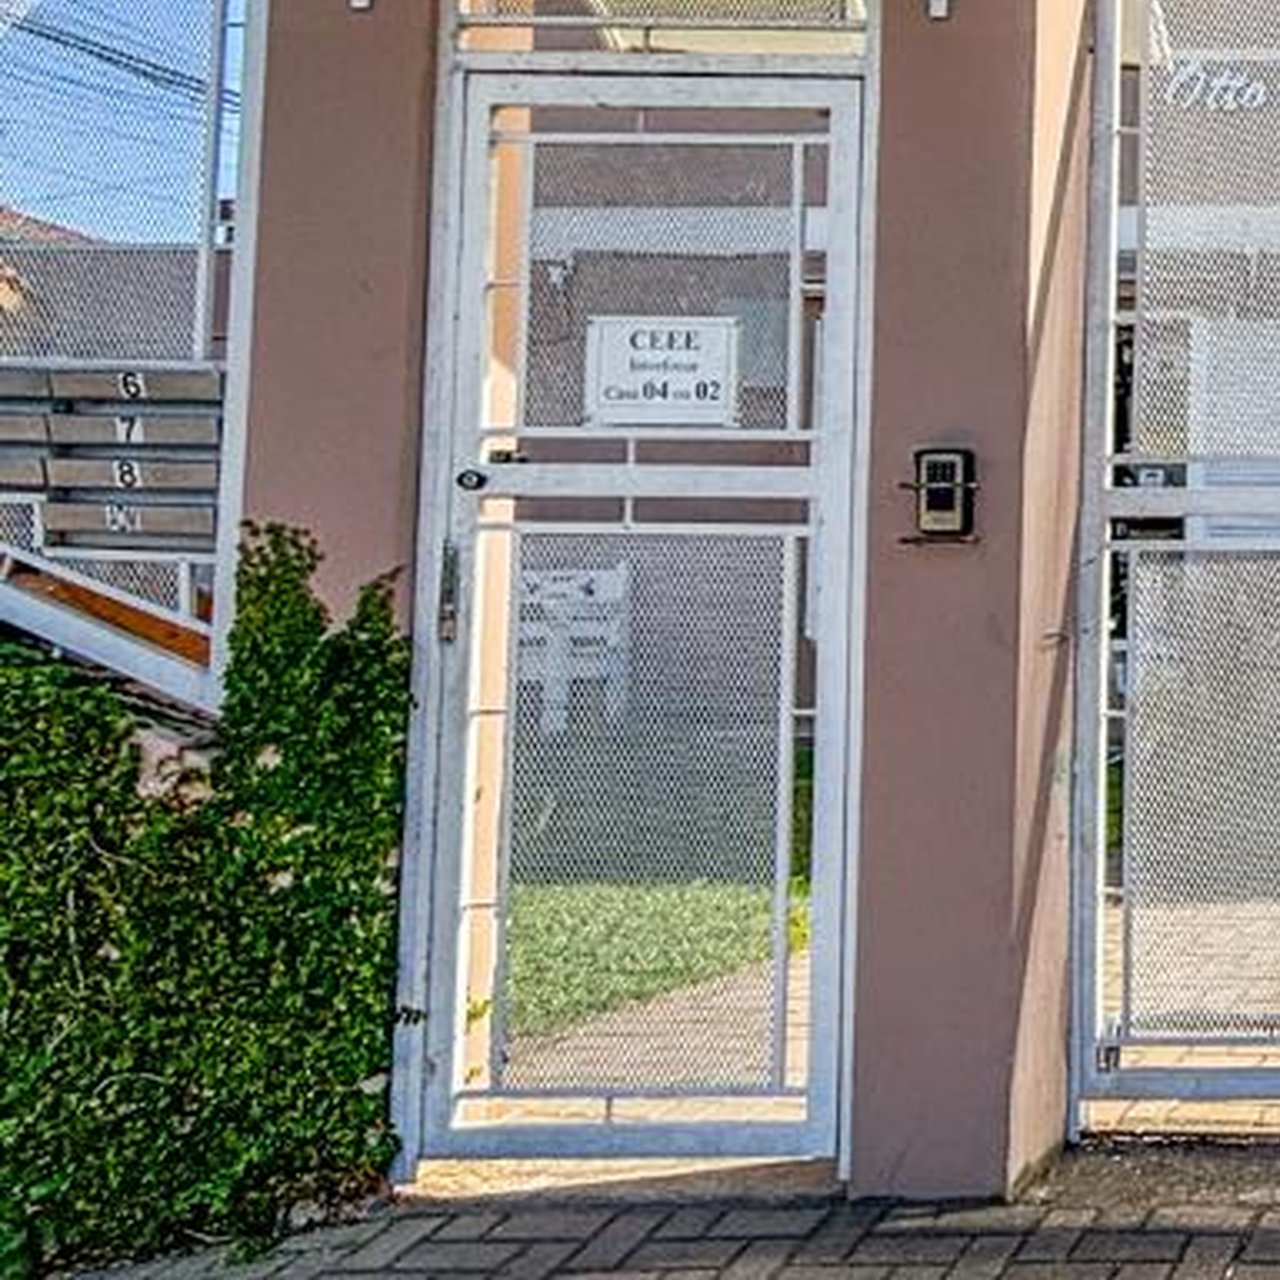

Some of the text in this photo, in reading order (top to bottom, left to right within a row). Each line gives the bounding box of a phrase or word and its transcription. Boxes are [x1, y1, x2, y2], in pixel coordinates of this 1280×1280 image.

[629, 330, 700, 351] CEEE
[122, 372, 141, 398] 6
[642, 380, 668, 400] 04
[695, 380, 721, 400] 02
[119, 416, 136, 441] 7
[118, 461, 136, 488] 8
